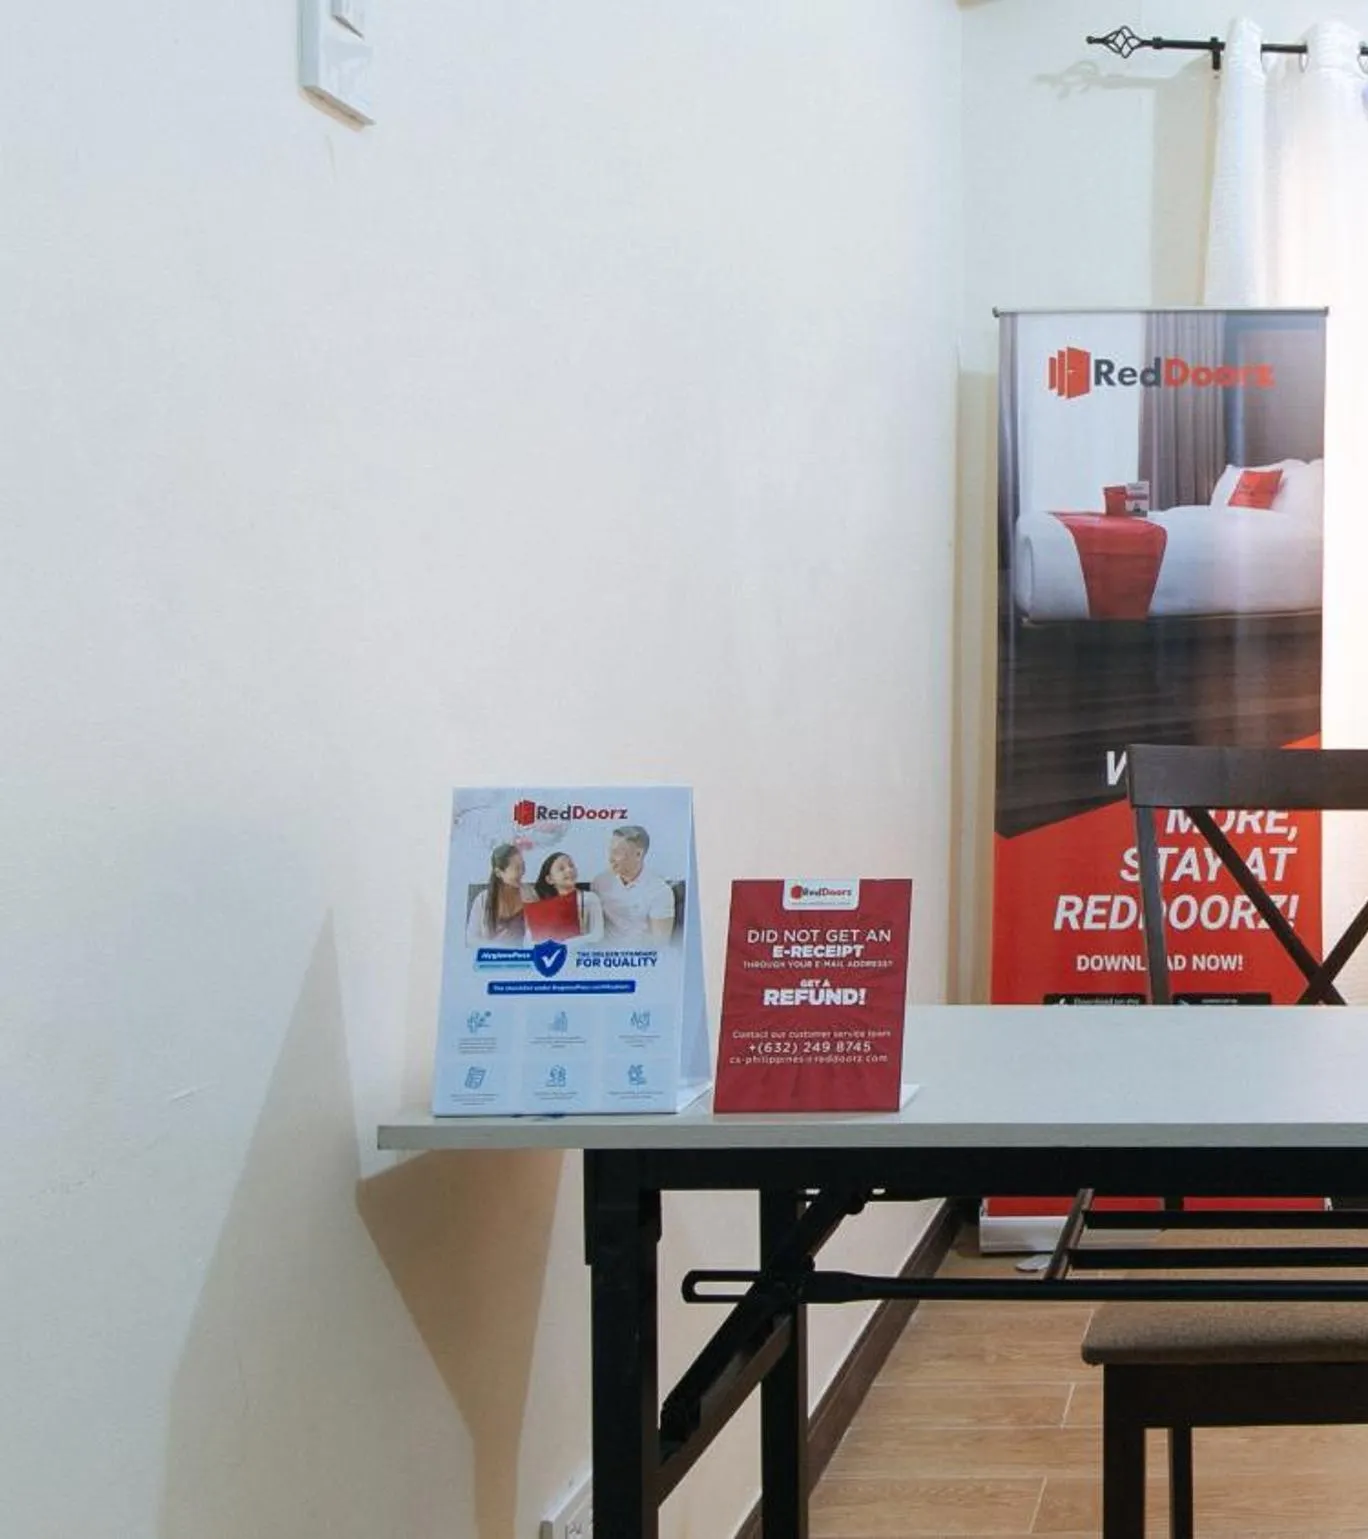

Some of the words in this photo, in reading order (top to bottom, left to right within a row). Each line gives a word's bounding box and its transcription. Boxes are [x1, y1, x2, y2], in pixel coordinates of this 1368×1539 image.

[1094, 357, 1276, 388] RedDoorz
[536, 804, 628, 820] RedDoorz
[1120, 847, 1223, 882] STAY
[1245, 847, 1298, 882] AT
[1053, 895, 1300, 930] REDOORZ!
[747, 929, 778, 943] DID
[784, 929, 821, 942] NOT
[825, 929, 860, 942] GET
[865, 929, 892, 942] AN
[772, 944, 864, 958] E-RECEIPT
[576, 958, 601, 968] FOR
[603, 957, 658, 968] QUALITY
[788, 960, 813, 968] YOUR
[1192, 954, 1243, 971] NOW!
[800, 979, 821, 987] GET
[822, 979, 831, 987] A
[763, 988, 867, 1006] REFUND!
[749, 1041, 798, 1054] +(632)
[803, 1041, 831, 1053] 249
